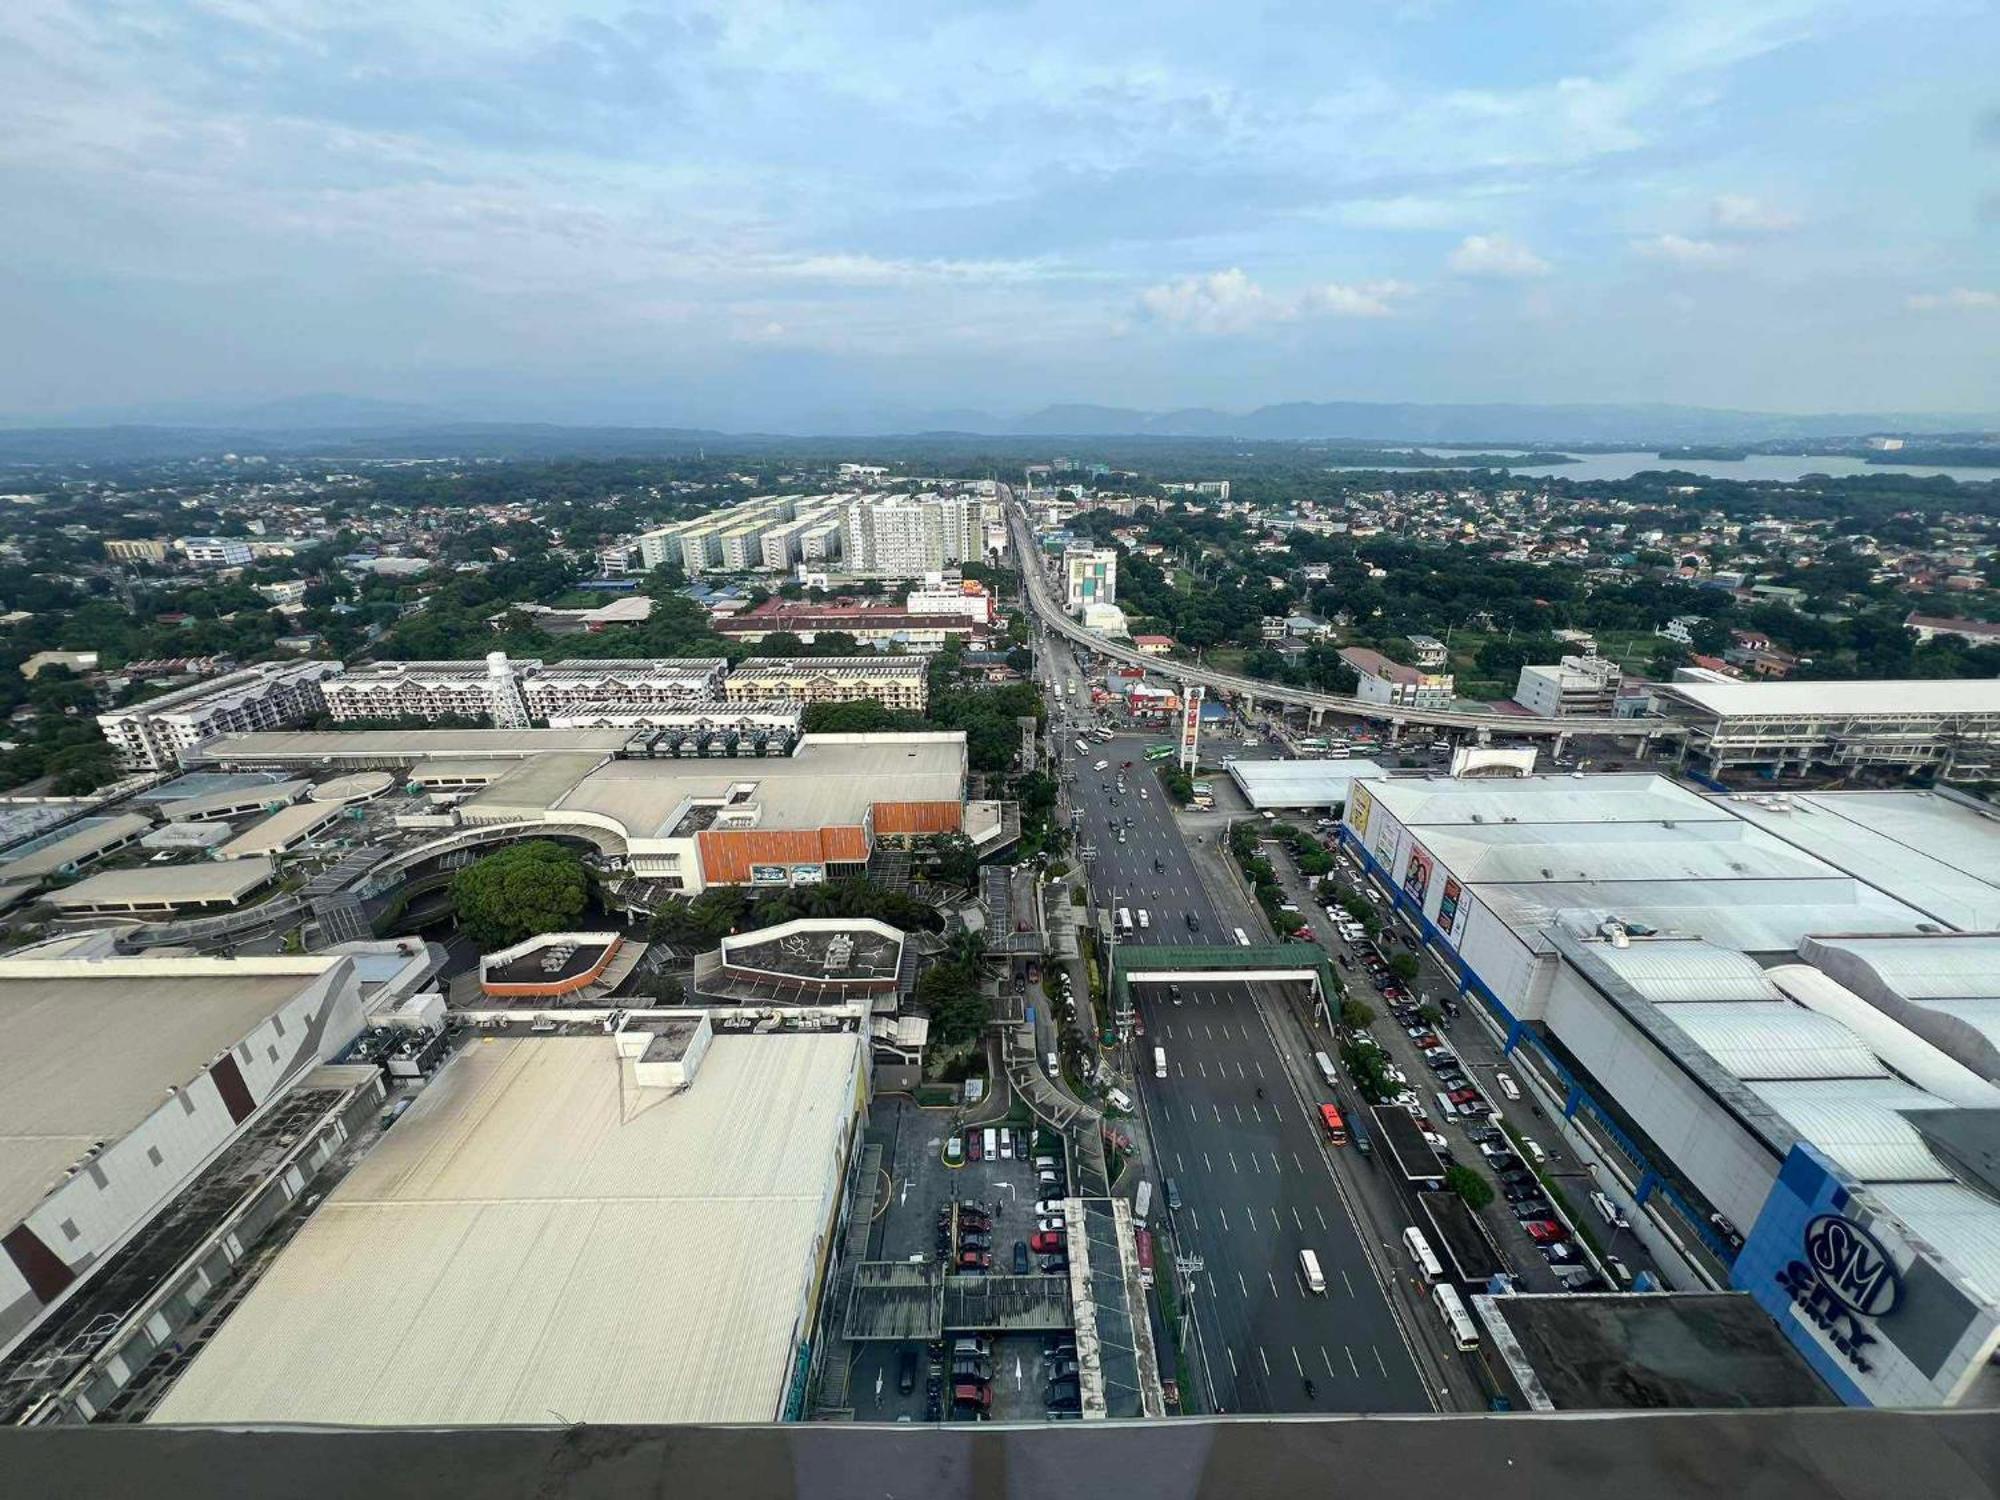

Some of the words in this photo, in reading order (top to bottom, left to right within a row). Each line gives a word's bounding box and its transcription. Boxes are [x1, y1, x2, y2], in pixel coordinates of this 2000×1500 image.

[1787, 1260, 1877, 1347] CITY
[1810, 1219, 1887, 1313] SM
[1775, 1270, 1872, 1373] FAIRVIEW
